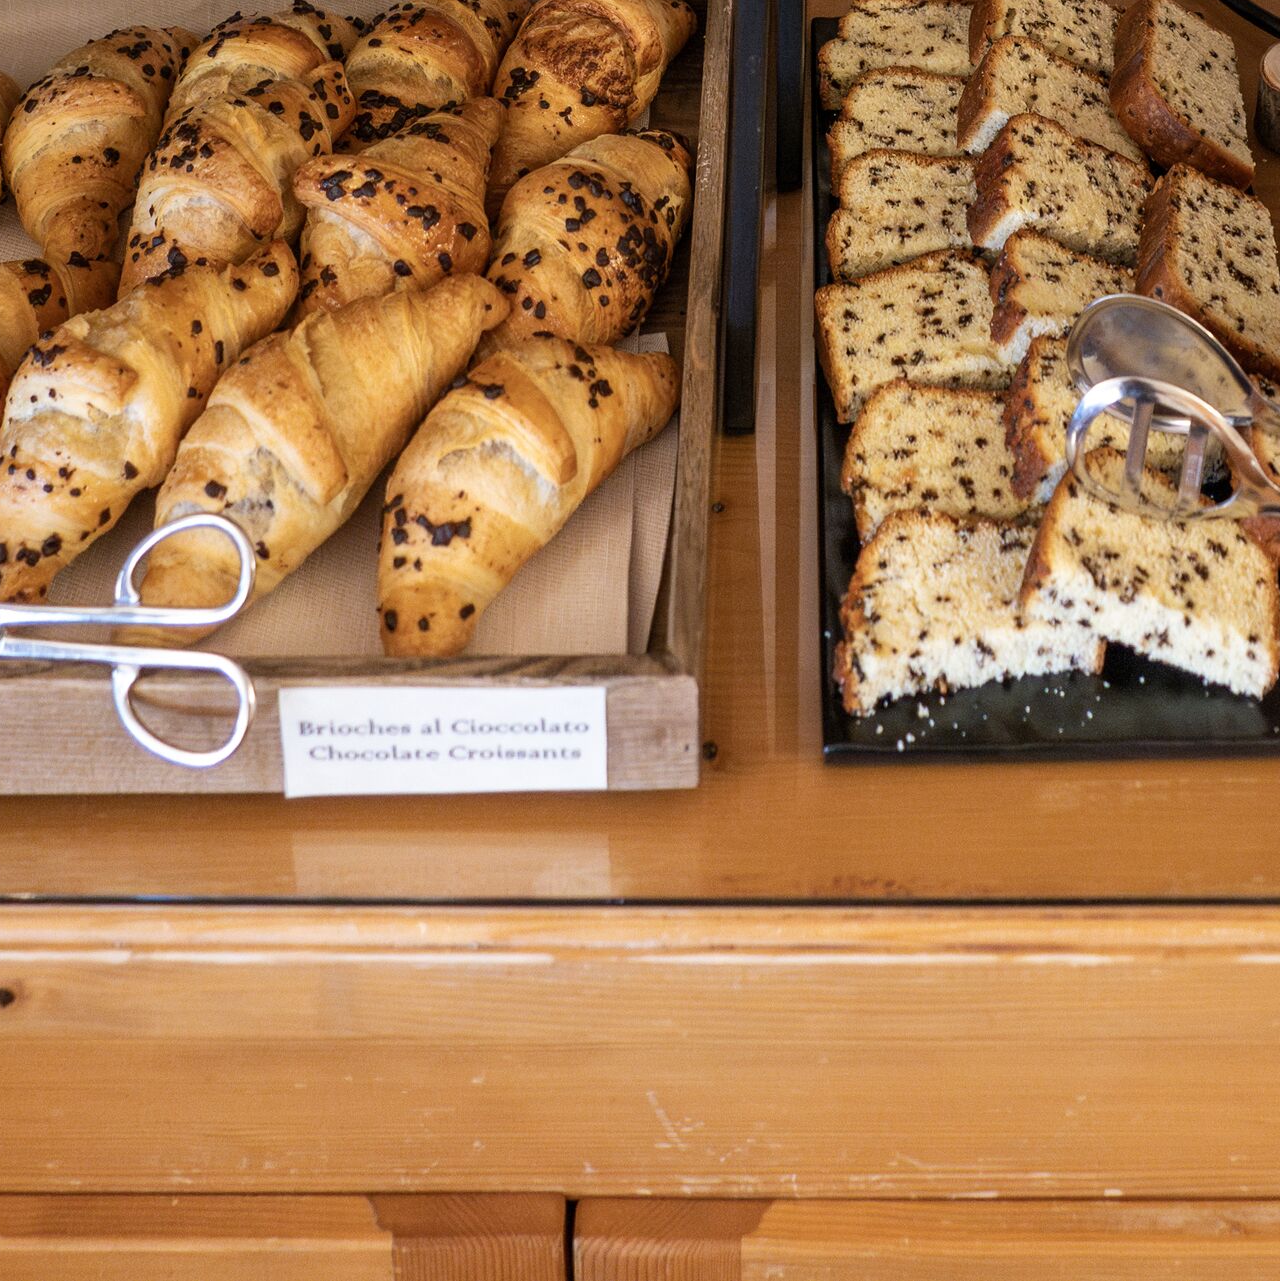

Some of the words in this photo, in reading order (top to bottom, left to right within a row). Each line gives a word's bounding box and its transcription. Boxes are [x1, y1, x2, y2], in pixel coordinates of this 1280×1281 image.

[298, 719, 412, 737] Brioches
[421, 718, 442, 735] al
[451, 718, 590, 735] Cioccolato
[308, 744, 440, 761] Chocolate
[448, 744, 582, 761] Croissants
